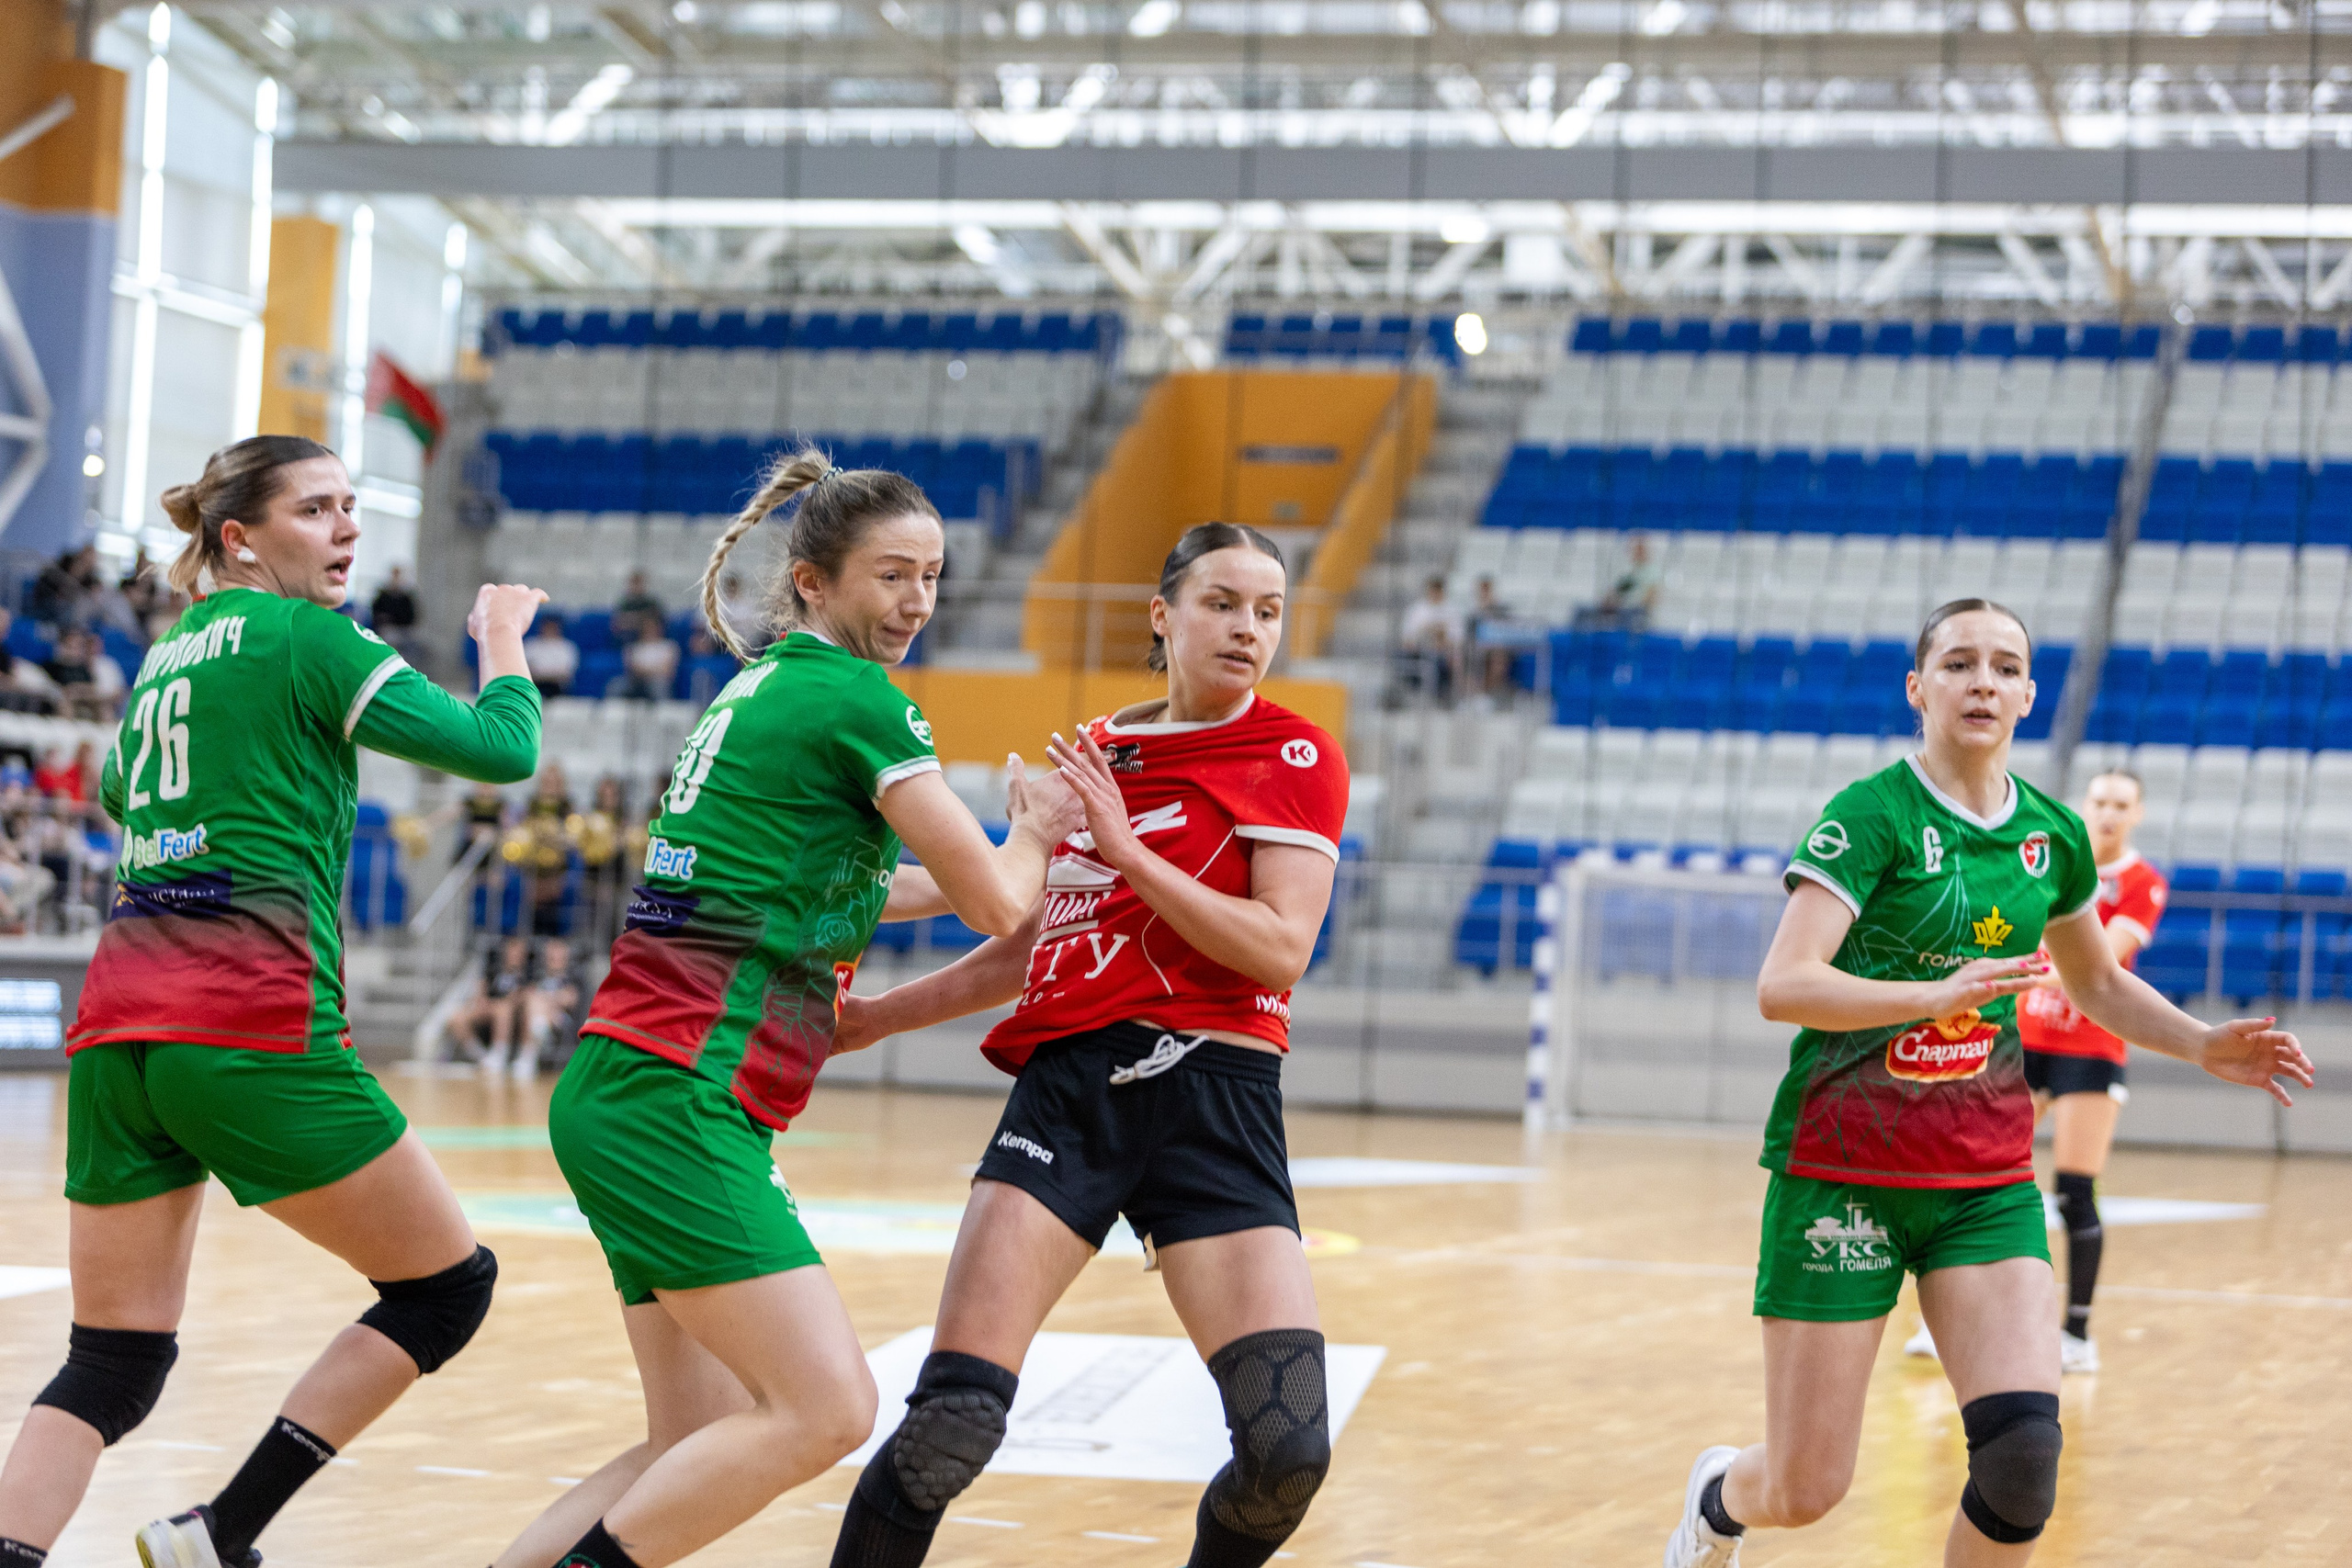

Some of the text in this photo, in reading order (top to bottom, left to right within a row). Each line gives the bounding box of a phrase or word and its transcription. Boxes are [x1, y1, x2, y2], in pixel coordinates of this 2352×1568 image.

[129, 676, 191, 811] 26
[134, 826, 208, 868] BelFert
[1923, 826, 1944, 873] 6
[998, 1131, 1054, 1165] Kempa
[1803, 1256, 1893, 1273] ГОРОДА ГОМЕЛЯ
[1811, 1239, 1889, 1258] УКС
